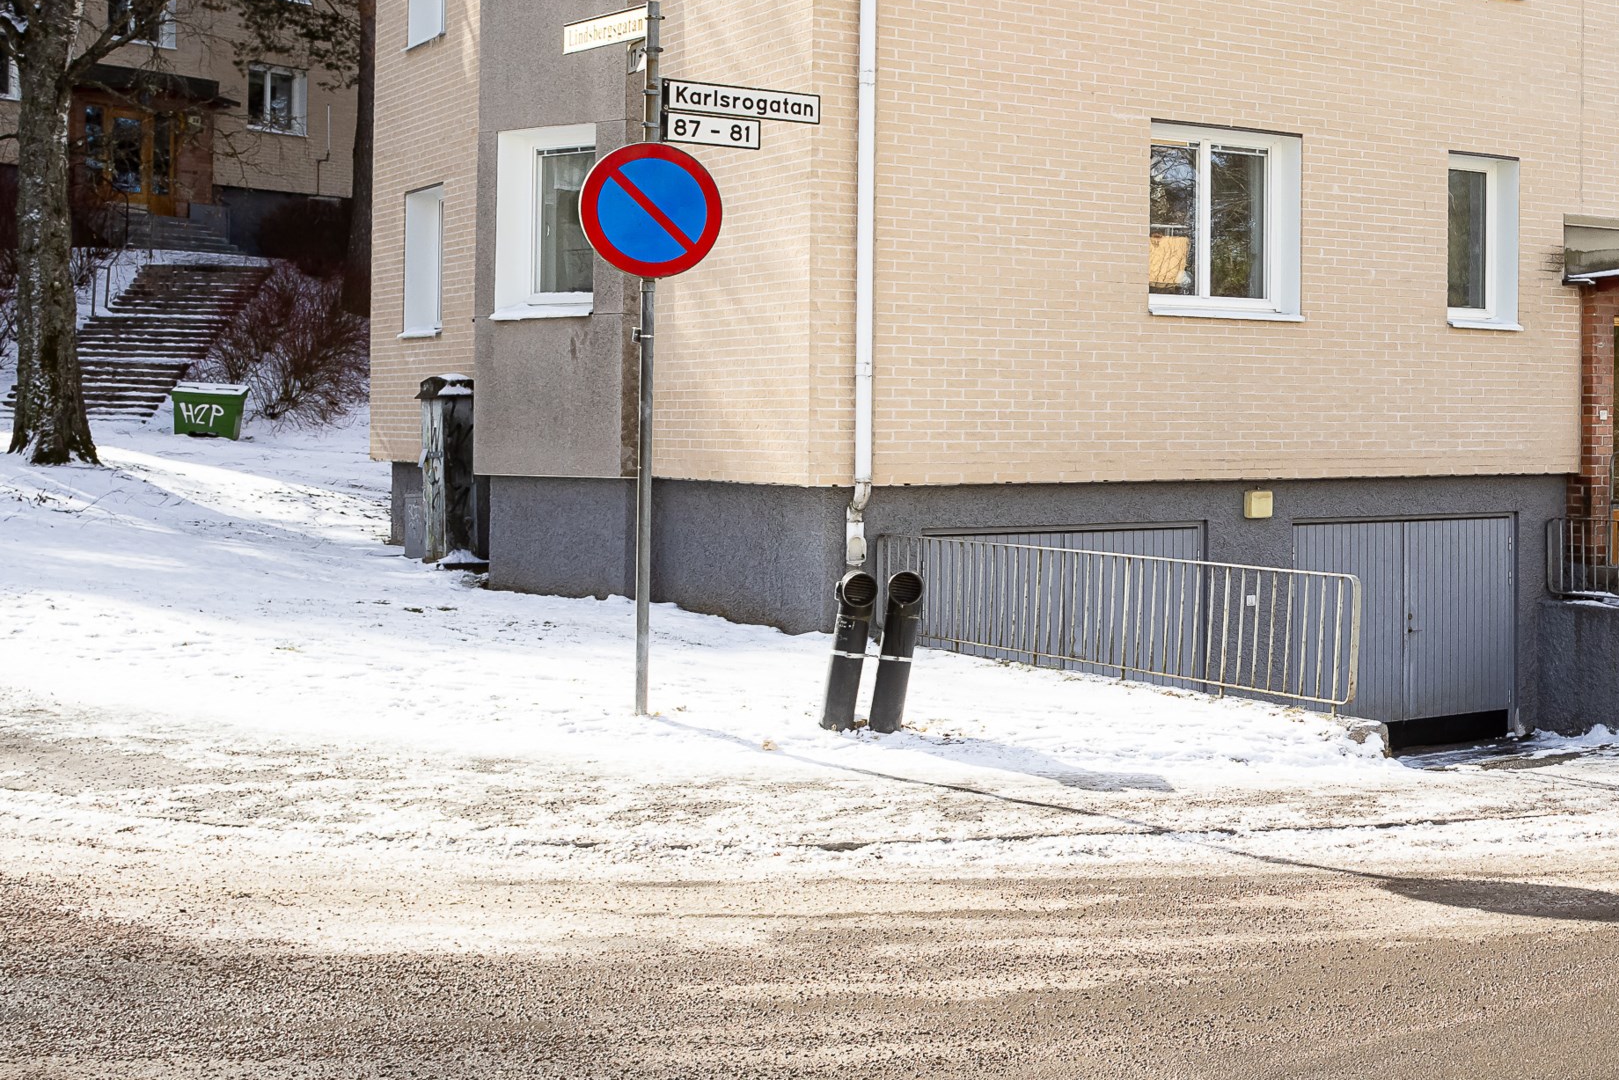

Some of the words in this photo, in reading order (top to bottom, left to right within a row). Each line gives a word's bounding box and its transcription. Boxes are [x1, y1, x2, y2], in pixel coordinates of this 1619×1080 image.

[568, 19, 643, 47] Lindsbergsgatan
[676, 85, 814, 117] Karlsrogatan
[674, 119, 701, 138] 87
[730, 124, 751, 142] 81
